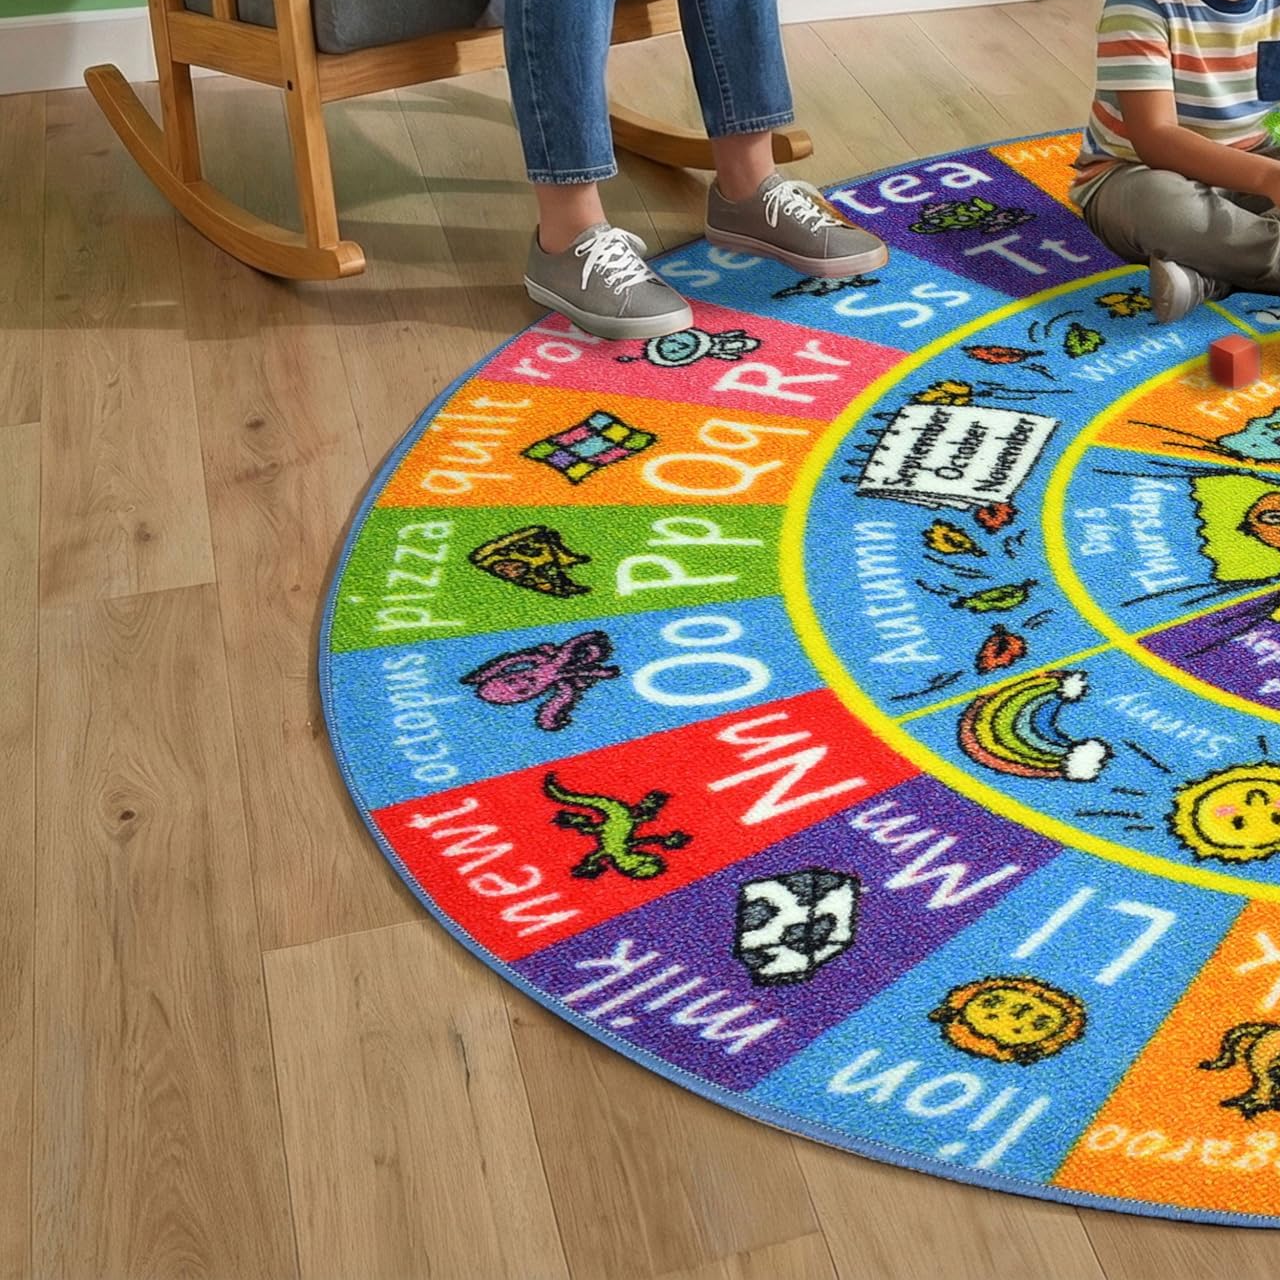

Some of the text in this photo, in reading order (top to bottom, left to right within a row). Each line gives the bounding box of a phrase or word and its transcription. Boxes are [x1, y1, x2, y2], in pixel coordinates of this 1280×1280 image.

[827, 158, 994, 216] tea
[963, 232, 1092, 276] Tt
[832, 282, 974, 328] Ss
[711, 340, 851, 404] Rr
[1071, 330, 1187, 382] Windy
[420, 394, 532, 495] quilt
[642, 418, 811, 496] Qq
[882, 407, 953, 488] September
[934, 420, 989, 480] October
[972, 417, 1039, 493] November
[347, 520, 464, 631] pizza
[616, 516, 764, 596] Pp
[1111, 476, 1190, 595] Thursday
[853, 520, 944, 665] Autumn
[632, 615, 772, 707] Oo
[382, 652, 467, 785] octopus
[1103, 690, 1234, 760] Sunny
[707, 711, 869, 827] Nn
[407, 796, 582, 938] newt
[849, 800, 1024, 910] Mm
[1008, 887, 1178, 987] Ll
[564, 938, 787, 1056] milk
[827, 1048, 1050, 1170] lion
